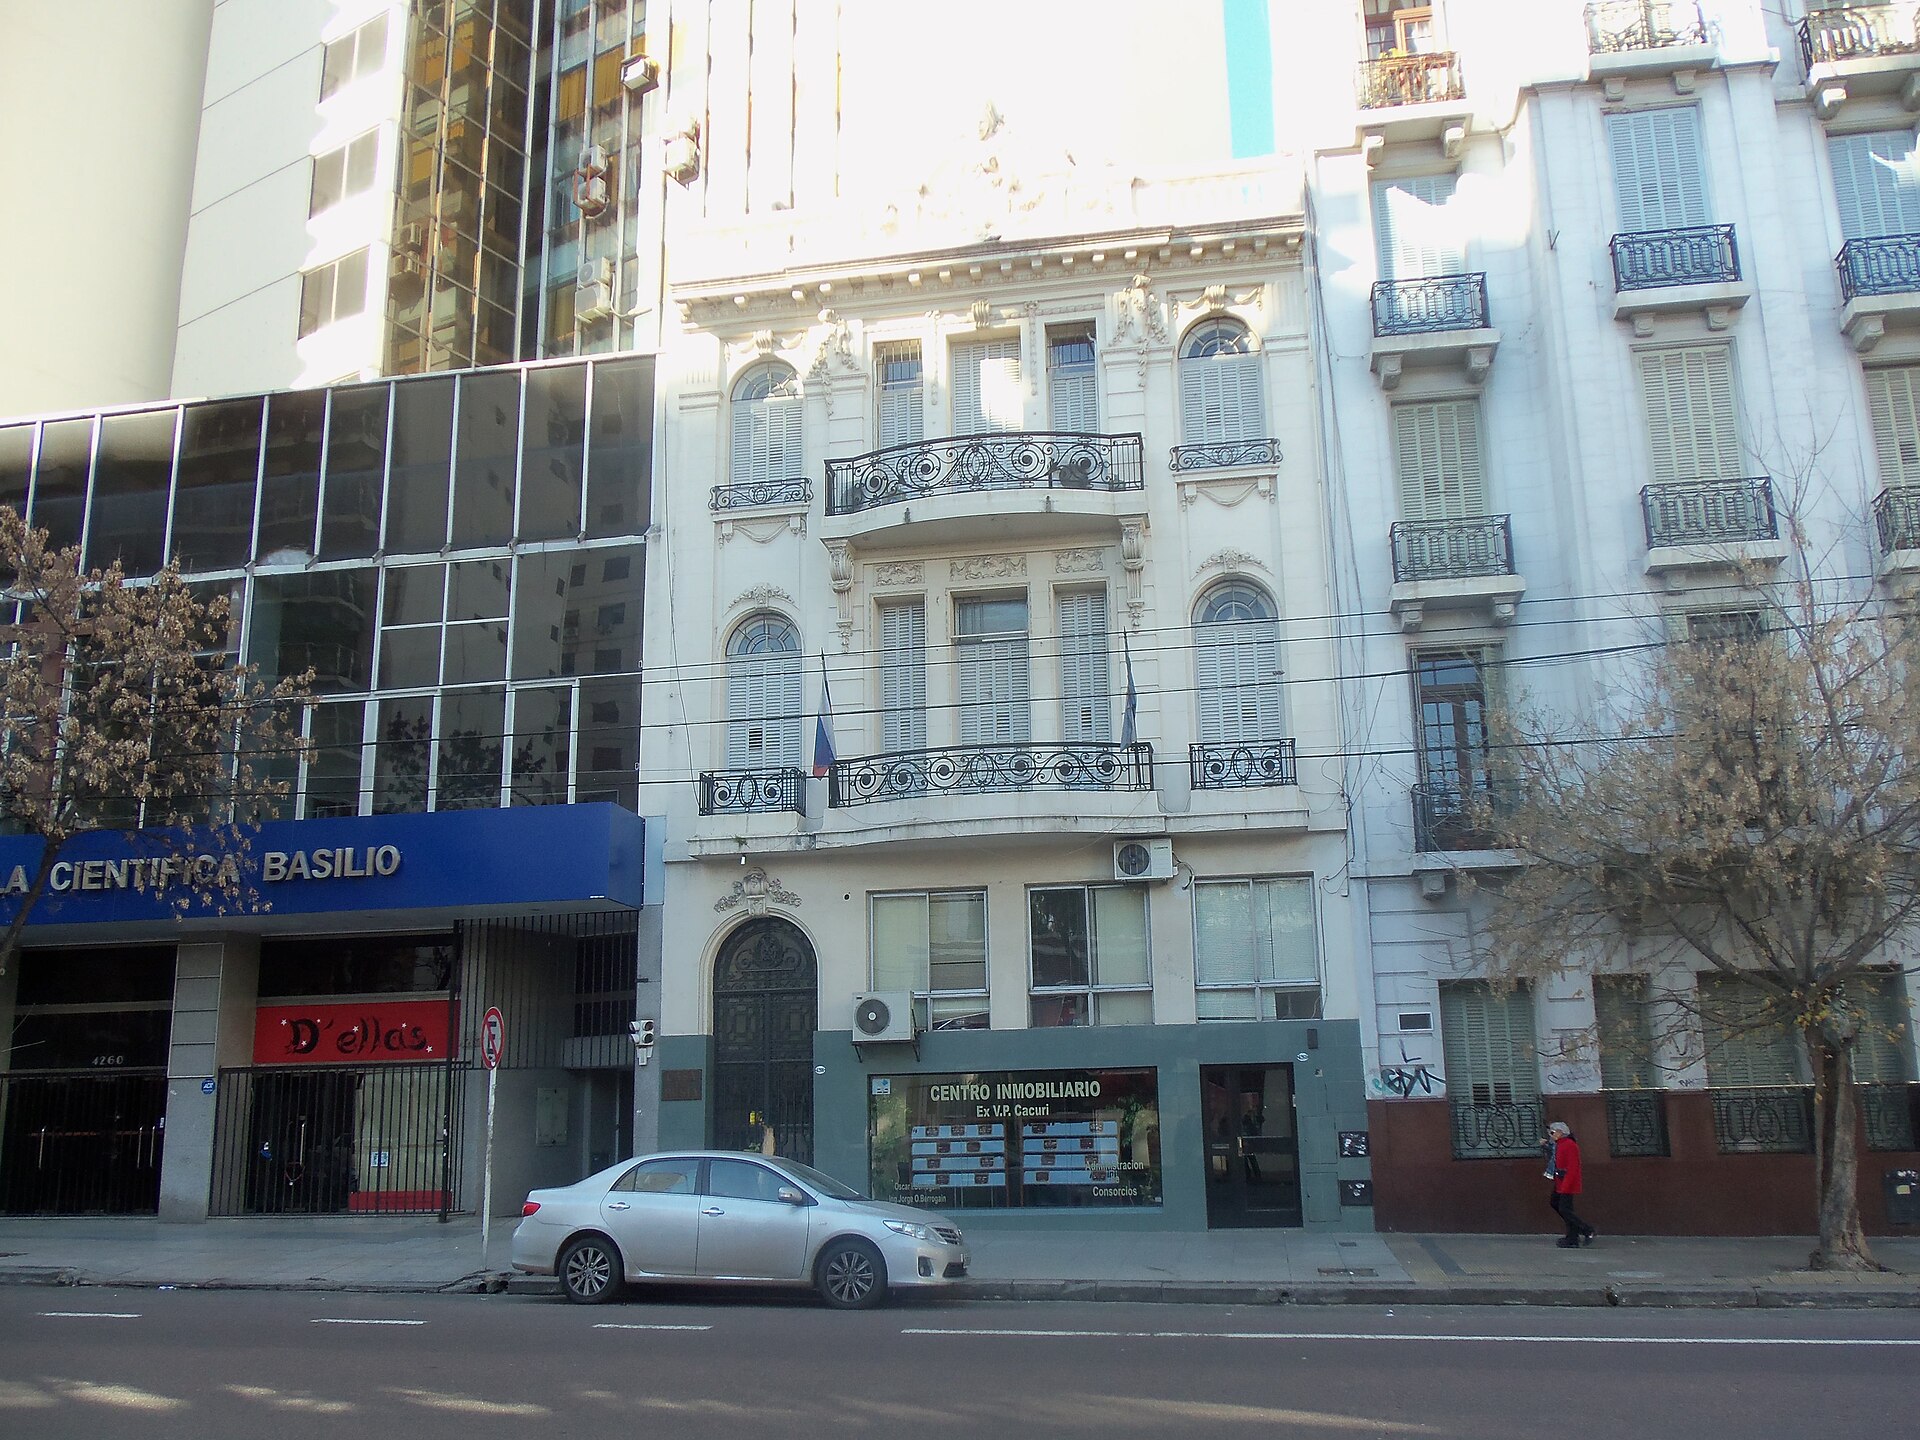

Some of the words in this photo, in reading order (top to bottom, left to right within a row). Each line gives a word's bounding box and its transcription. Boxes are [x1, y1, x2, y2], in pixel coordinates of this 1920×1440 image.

[0, 865, 31, 894] A
[50, 854, 241, 891] CIENTIFICA
[263, 845, 401, 882] BASILIO
[92, 1055, 125, 1066] 4260
[930, 1085, 991, 1102] CENTRO
[996, 1081, 1101, 1101] INMOBILIARIO
[976, 1105, 990, 1118] Ex
[993, 1105, 1011, 1117] V.P.
[1014, 1103, 1050, 1118] Cacuri
[1092, 1185, 1138, 1197] Consorcios
